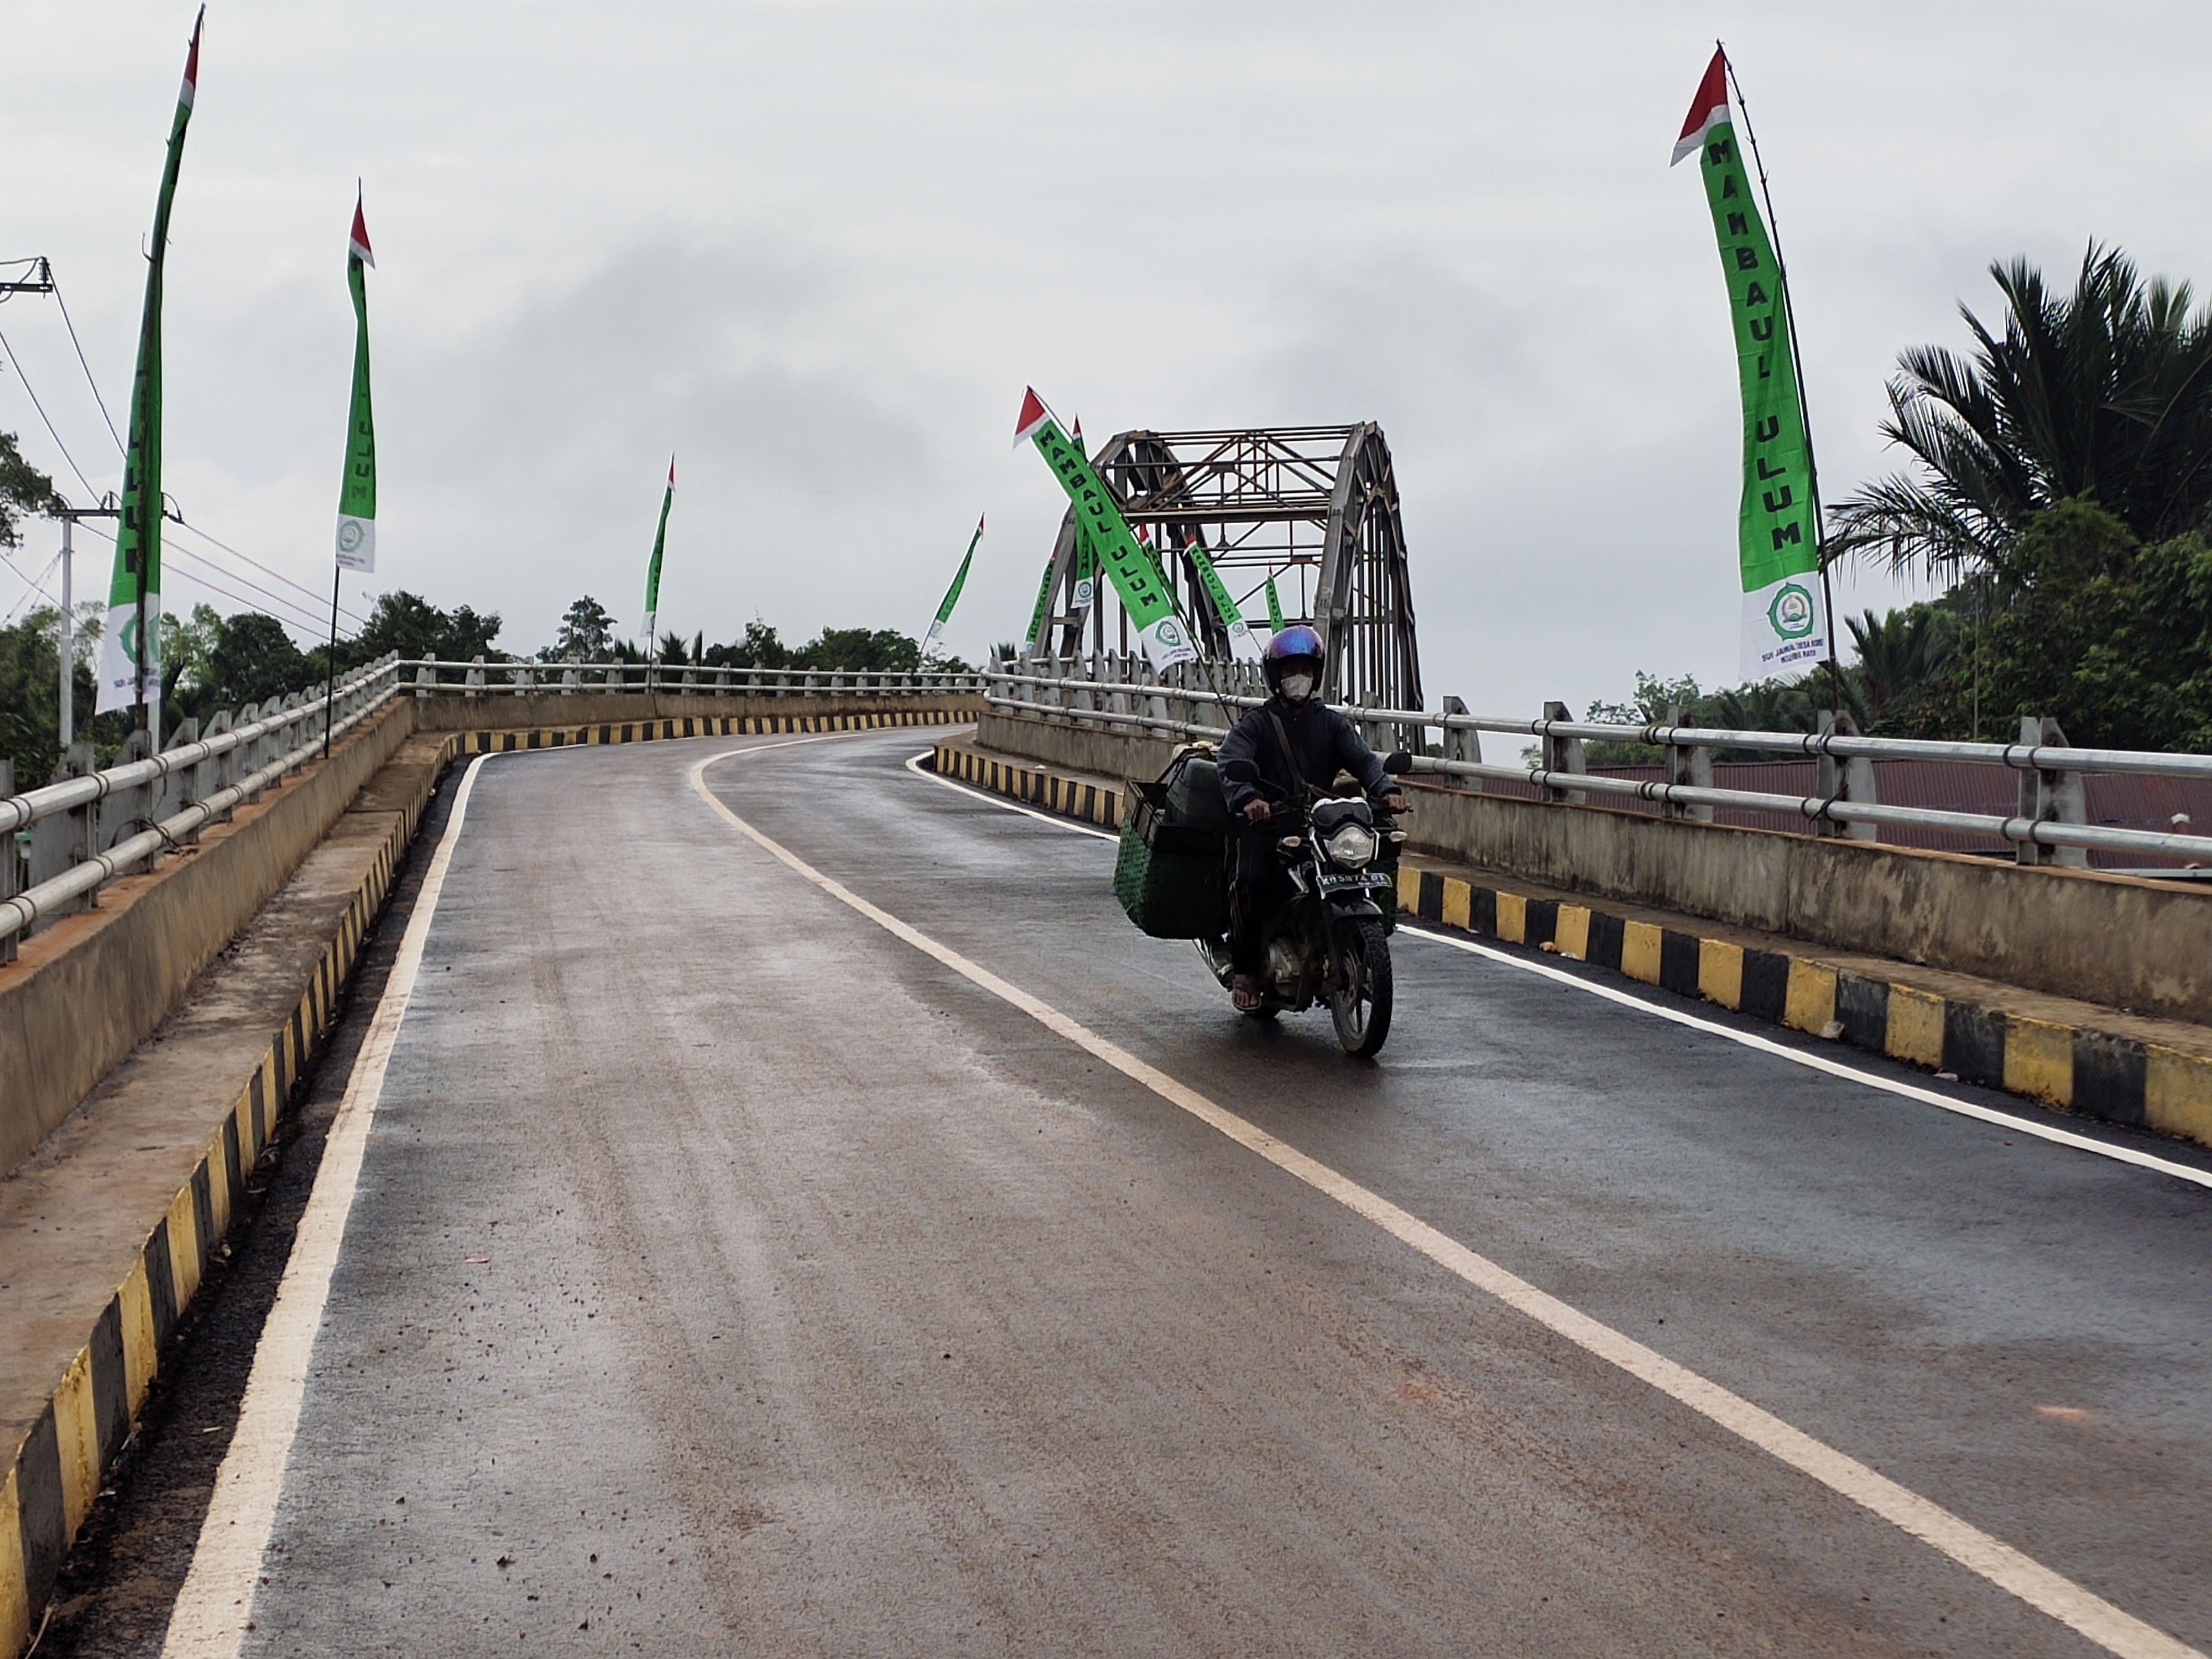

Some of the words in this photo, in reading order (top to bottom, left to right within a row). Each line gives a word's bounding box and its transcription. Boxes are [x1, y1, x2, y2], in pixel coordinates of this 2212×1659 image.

[1039, 429, 1112, 534] MAMBAUL
[1111, 545, 1157, 607] ULUM
[1756, 415, 1801, 551] ULUM
